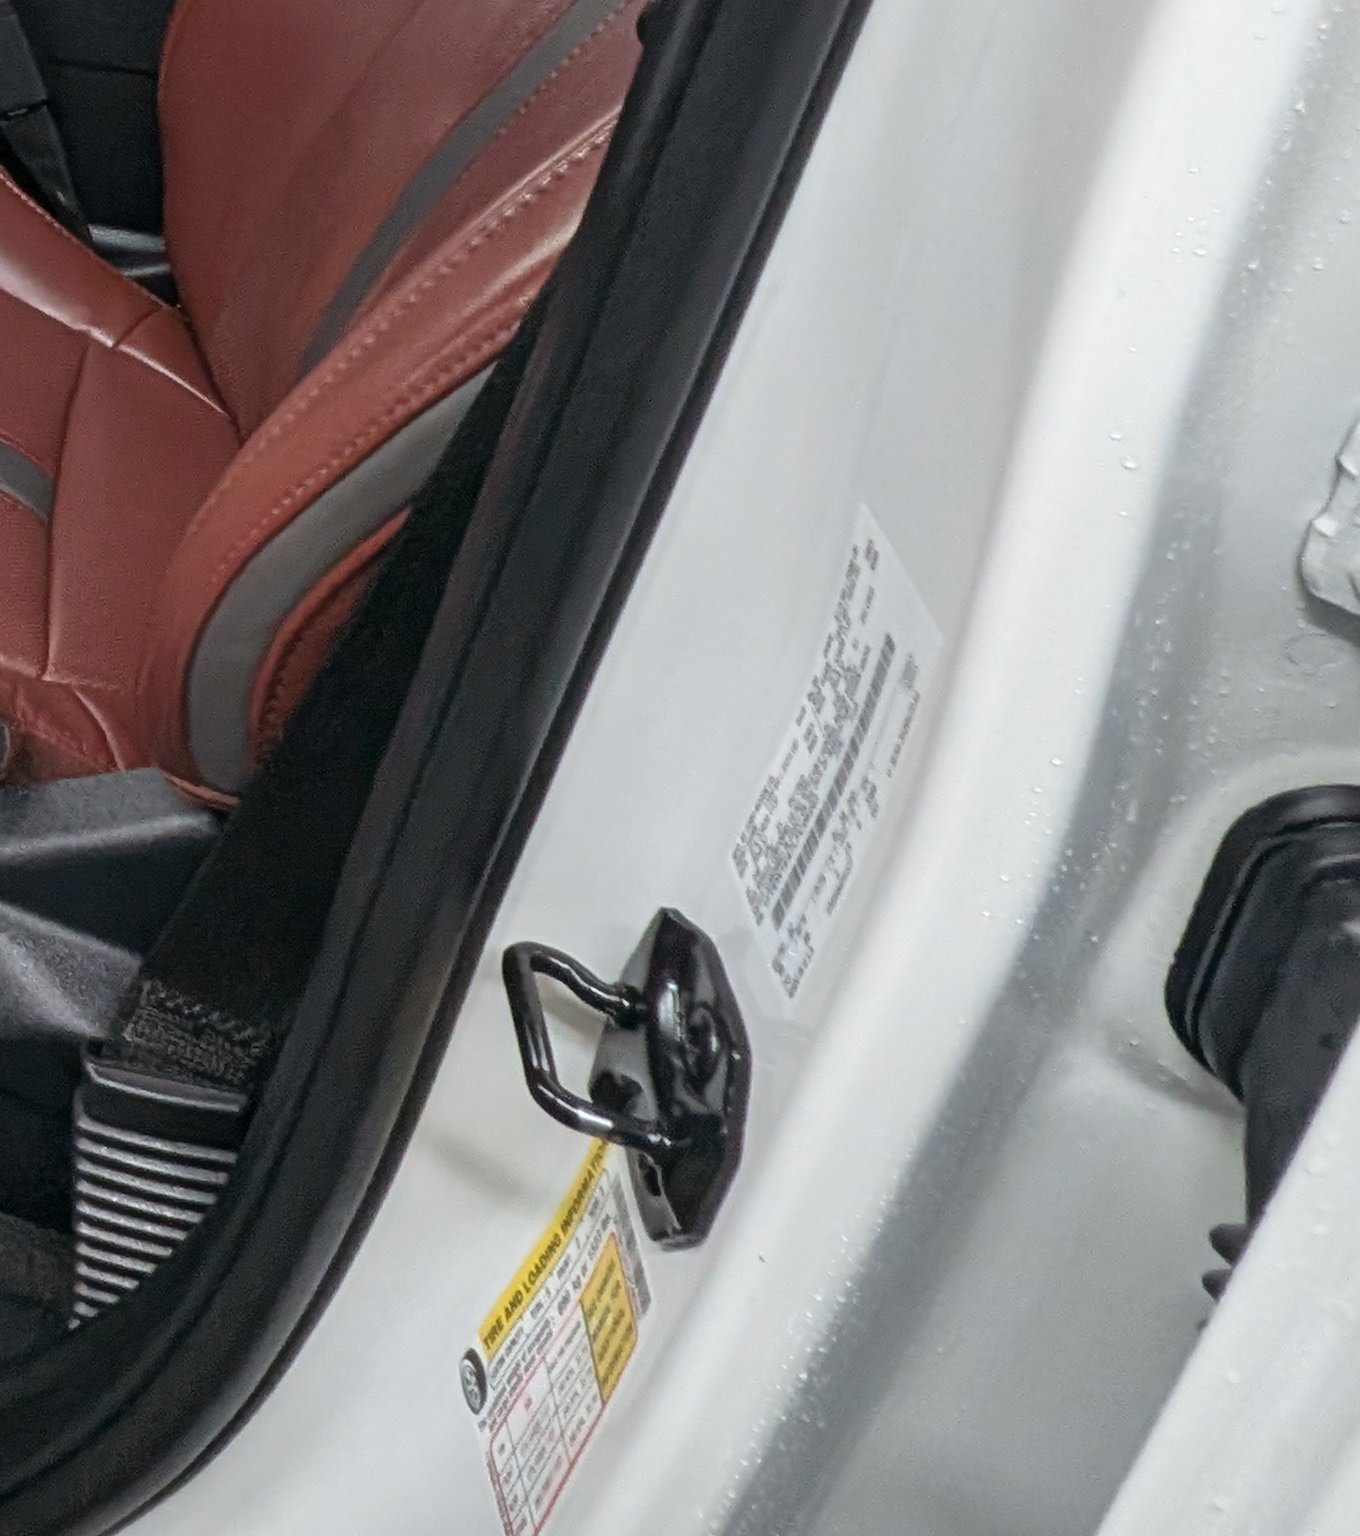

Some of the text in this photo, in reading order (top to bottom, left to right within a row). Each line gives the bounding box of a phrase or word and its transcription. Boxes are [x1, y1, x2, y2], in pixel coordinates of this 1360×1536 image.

[483, 1318, 505, 1351] TIRE
[503, 1290, 524, 1321] AND
[523, 1233, 561, 1292] LOADING
